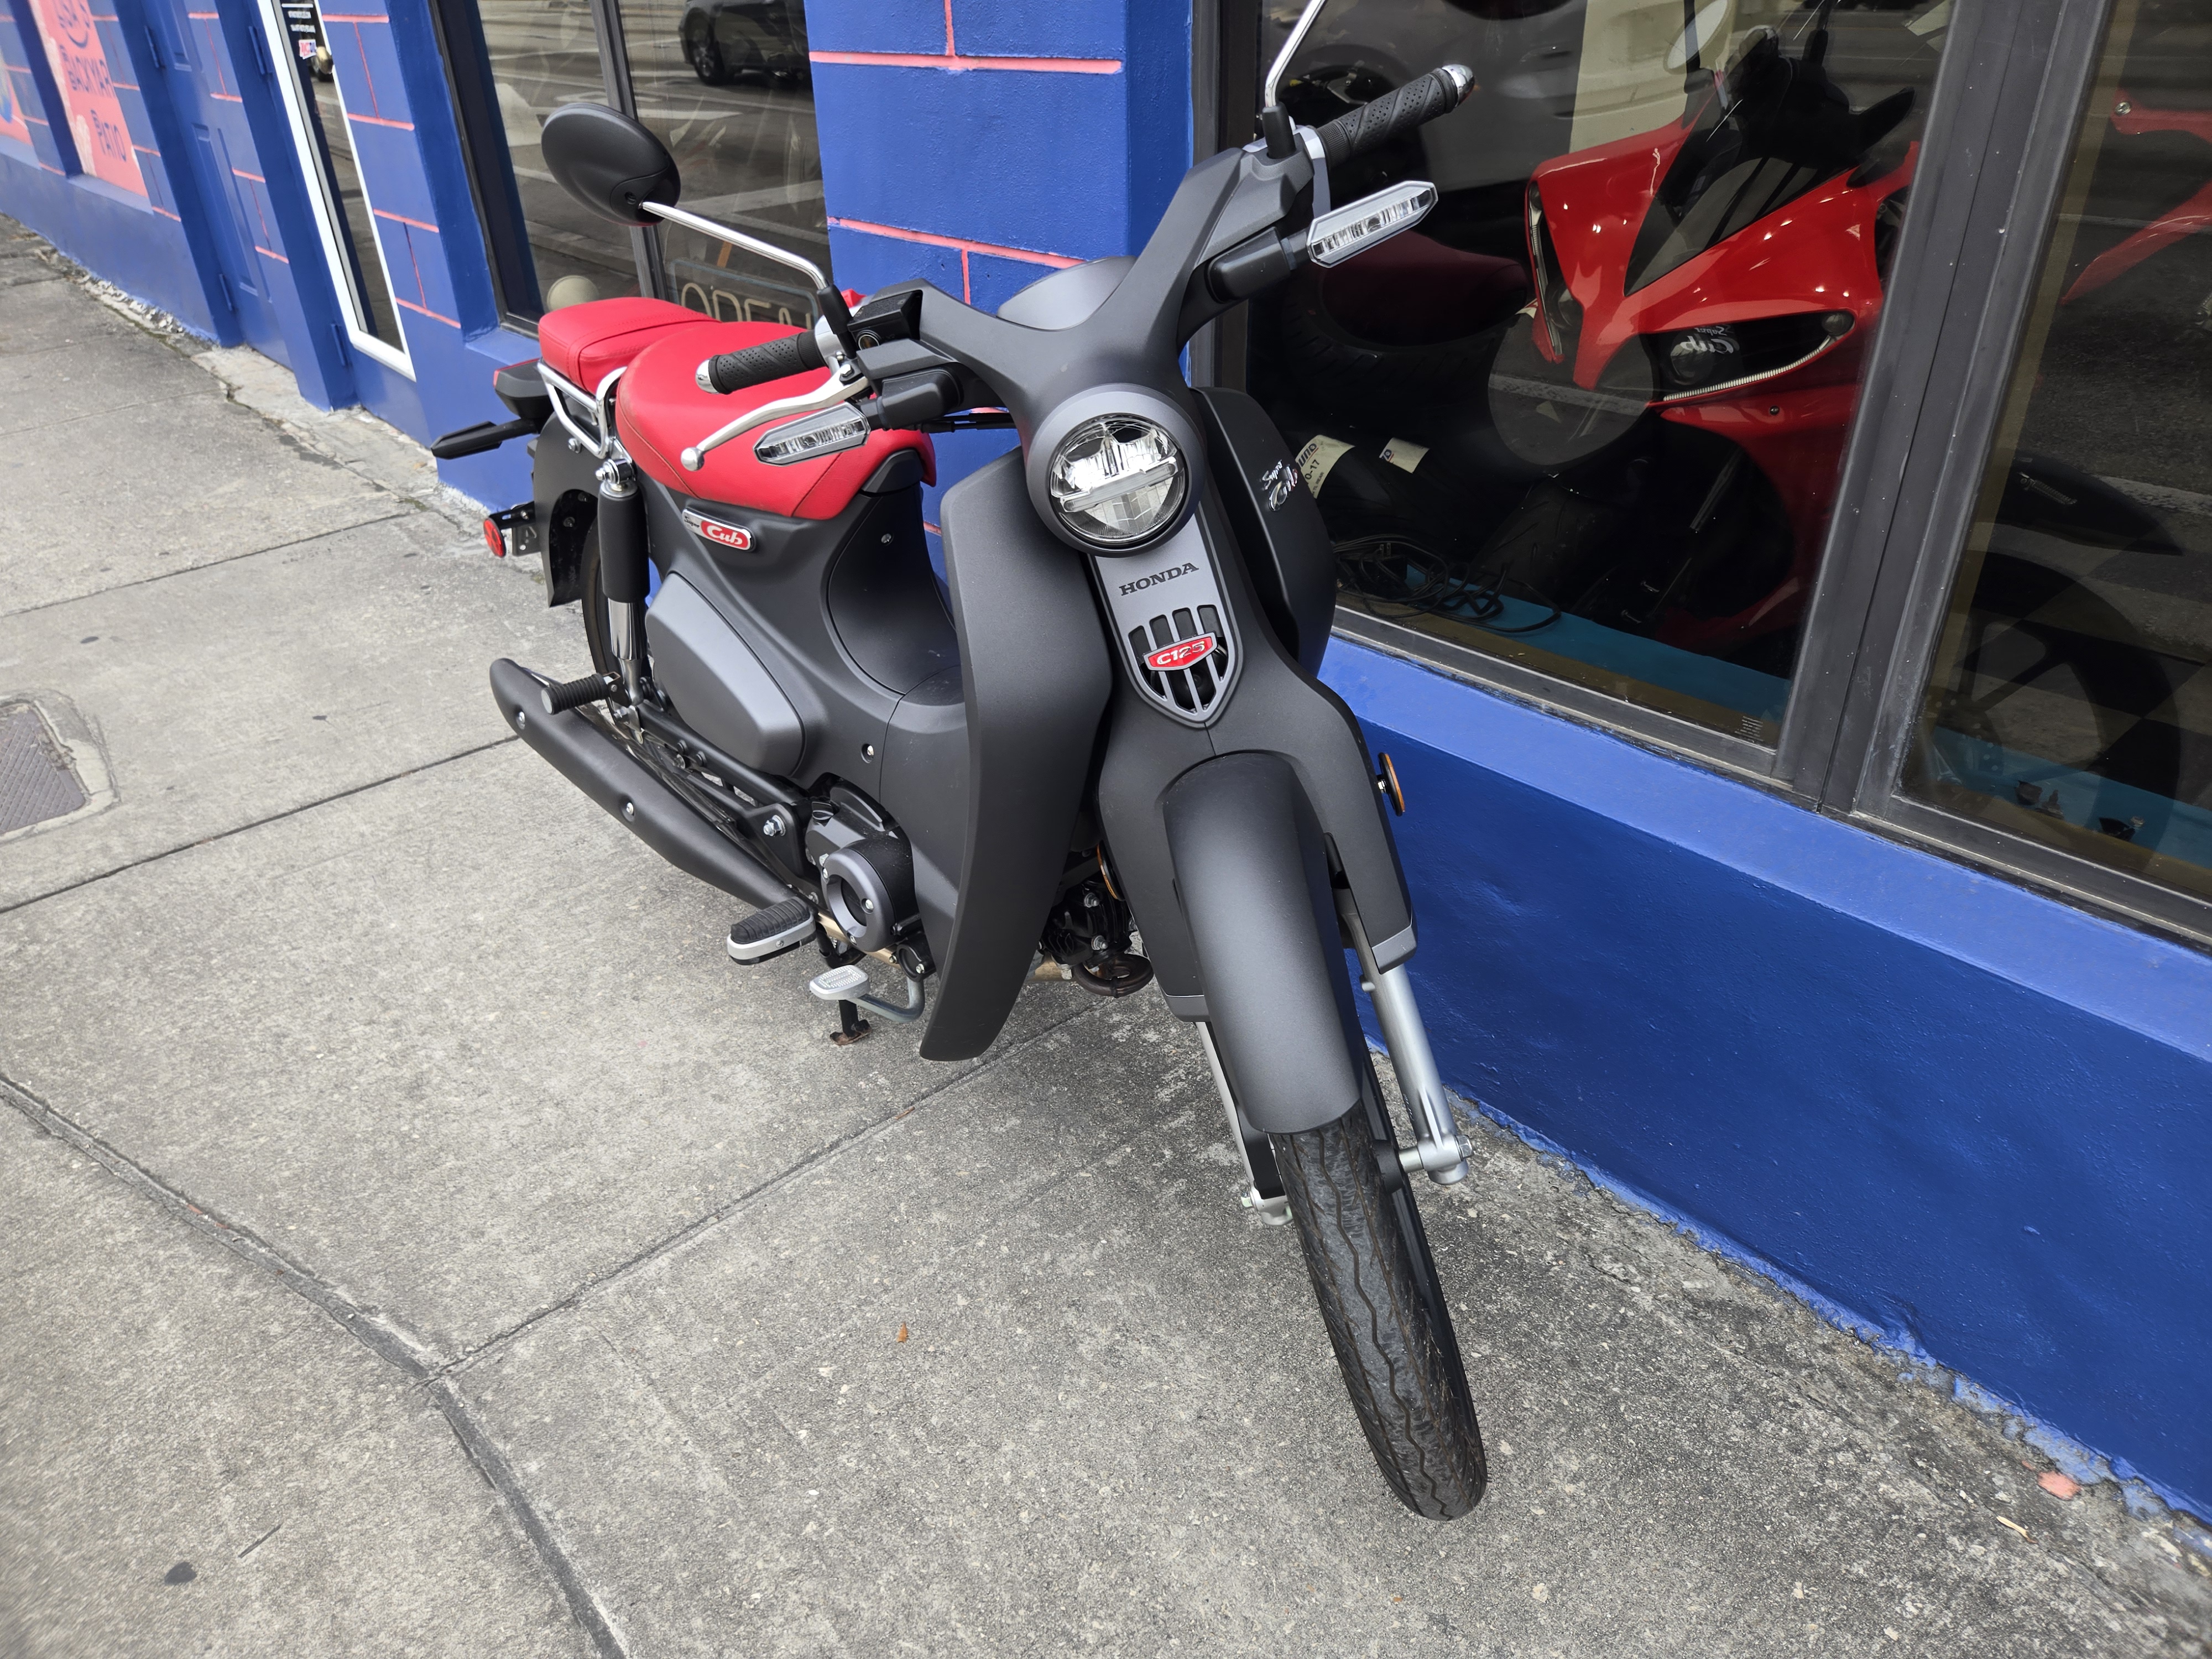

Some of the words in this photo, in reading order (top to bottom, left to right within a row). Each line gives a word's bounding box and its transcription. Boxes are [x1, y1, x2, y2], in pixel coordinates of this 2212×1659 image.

[684, 515, 700, 528] Super
[706, 525, 743, 545] Cub
[1118, 562, 1199, 596] HONDA
[1156, 640, 1206, 665] C125
